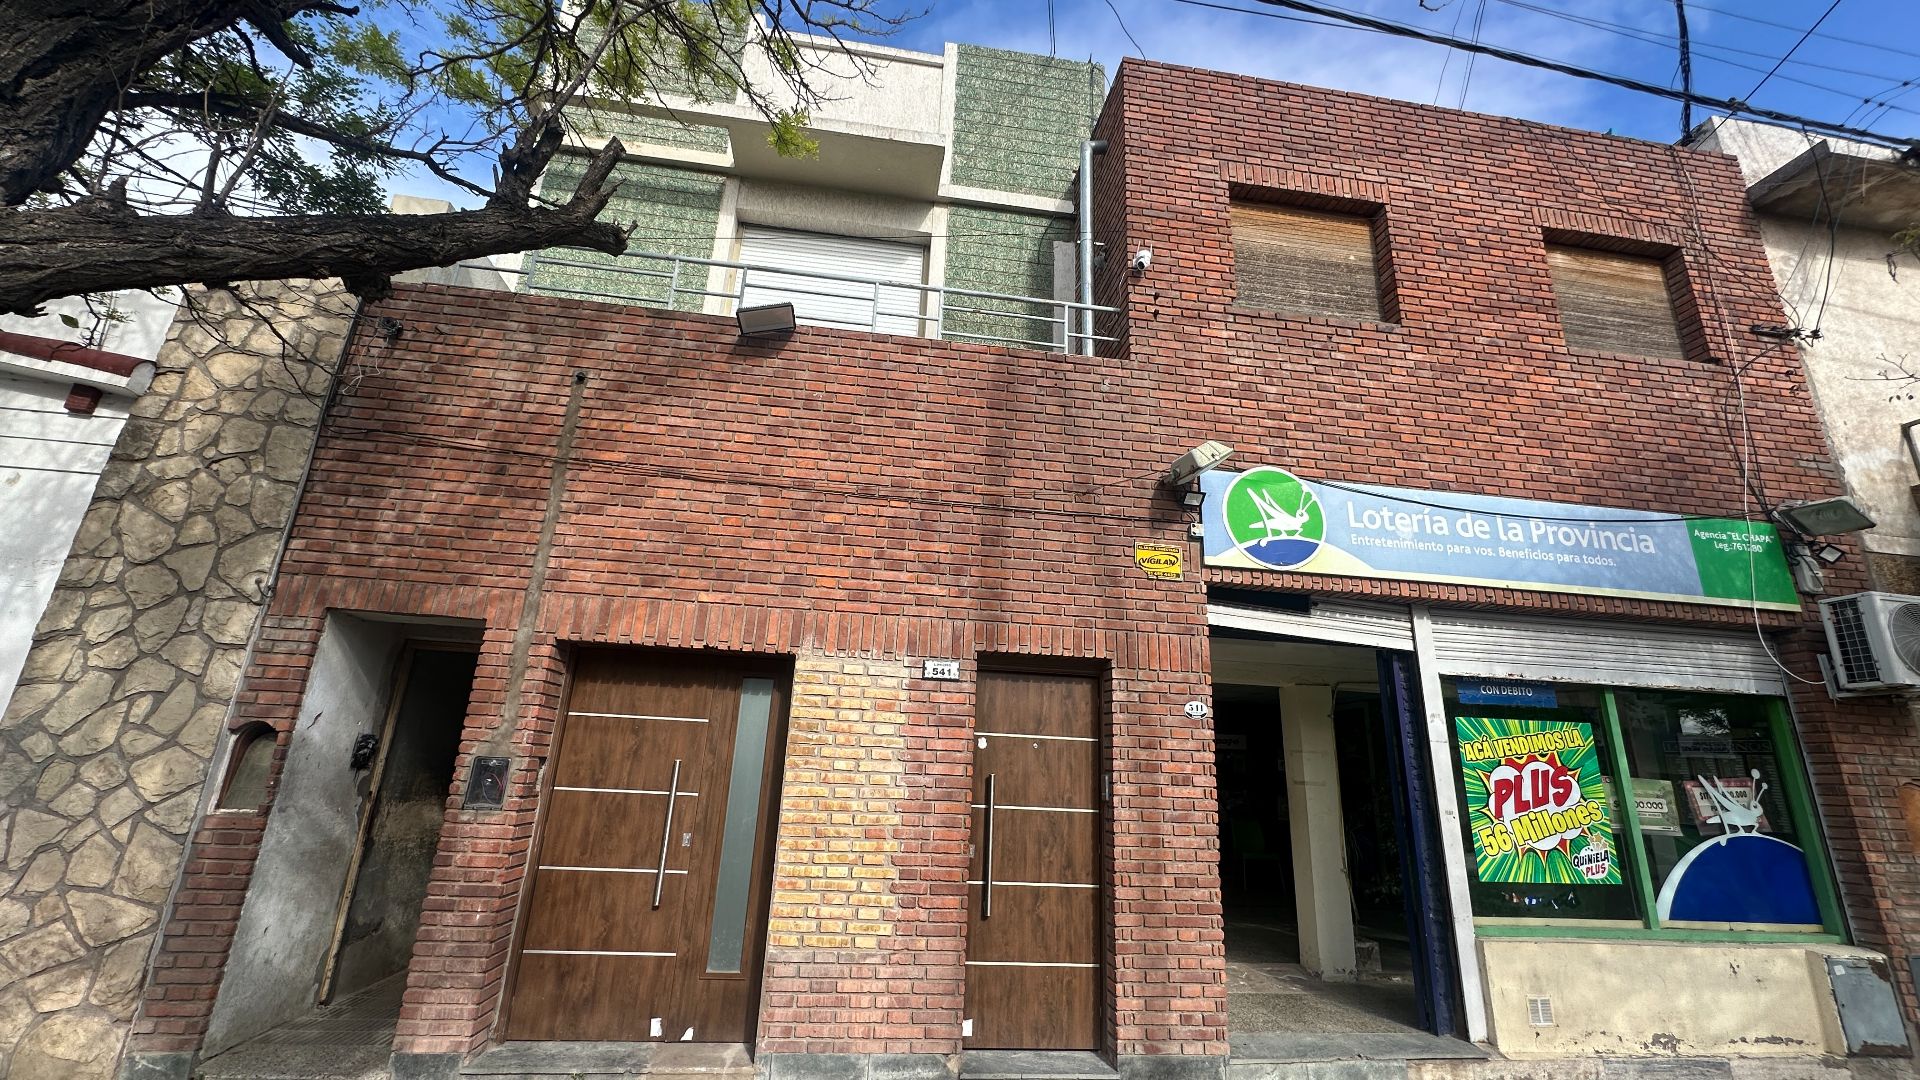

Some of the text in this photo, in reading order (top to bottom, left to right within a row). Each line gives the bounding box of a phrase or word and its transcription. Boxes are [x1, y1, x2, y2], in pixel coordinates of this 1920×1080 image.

[1347, 501, 1656, 554] Lotería de la Provincia
[1694, 529, 1727, 540] Agencia
[1351, 533, 1616, 567] Entretenimiento para vos. Beneficios para todos.
[932, 667, 951, 677] 541
[1480, 685, 1533, 696] CON DEBITO
[1464, 729, 1585, 761] ACÁ VENDIMOS LA
[1494, 766, 1572, 819] PLUS
[1478, 801, 1603, 856] 56 Millones
[1585, 863, 1606, 877] PLUS
